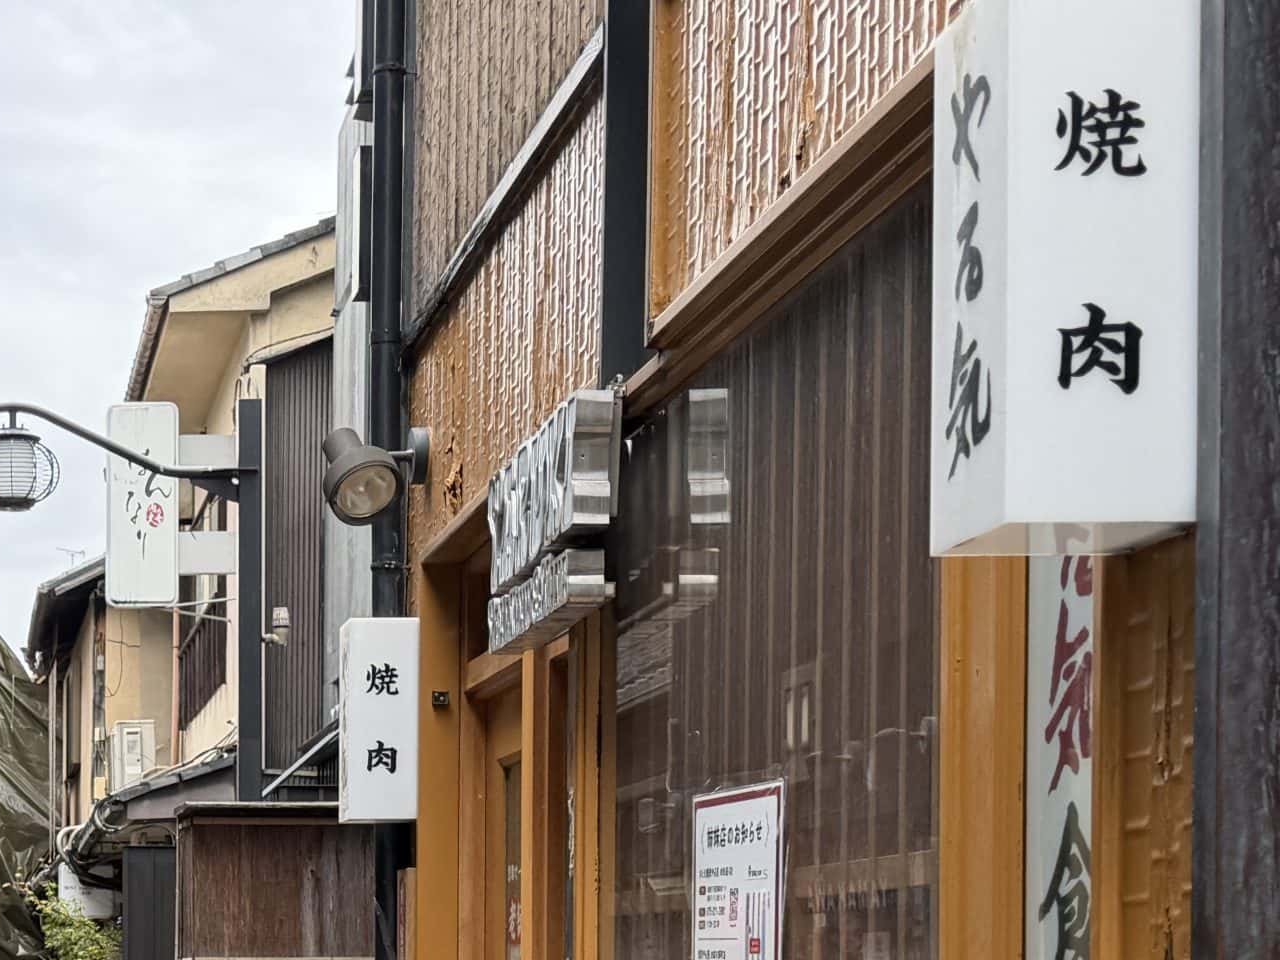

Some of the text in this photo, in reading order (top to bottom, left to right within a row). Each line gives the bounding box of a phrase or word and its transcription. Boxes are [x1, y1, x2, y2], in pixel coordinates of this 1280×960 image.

[945, 73, 992, 482] やる気
[1053, 88, 1148, 395] 焼肉
[365, 663, 400, 775] 焼肉
